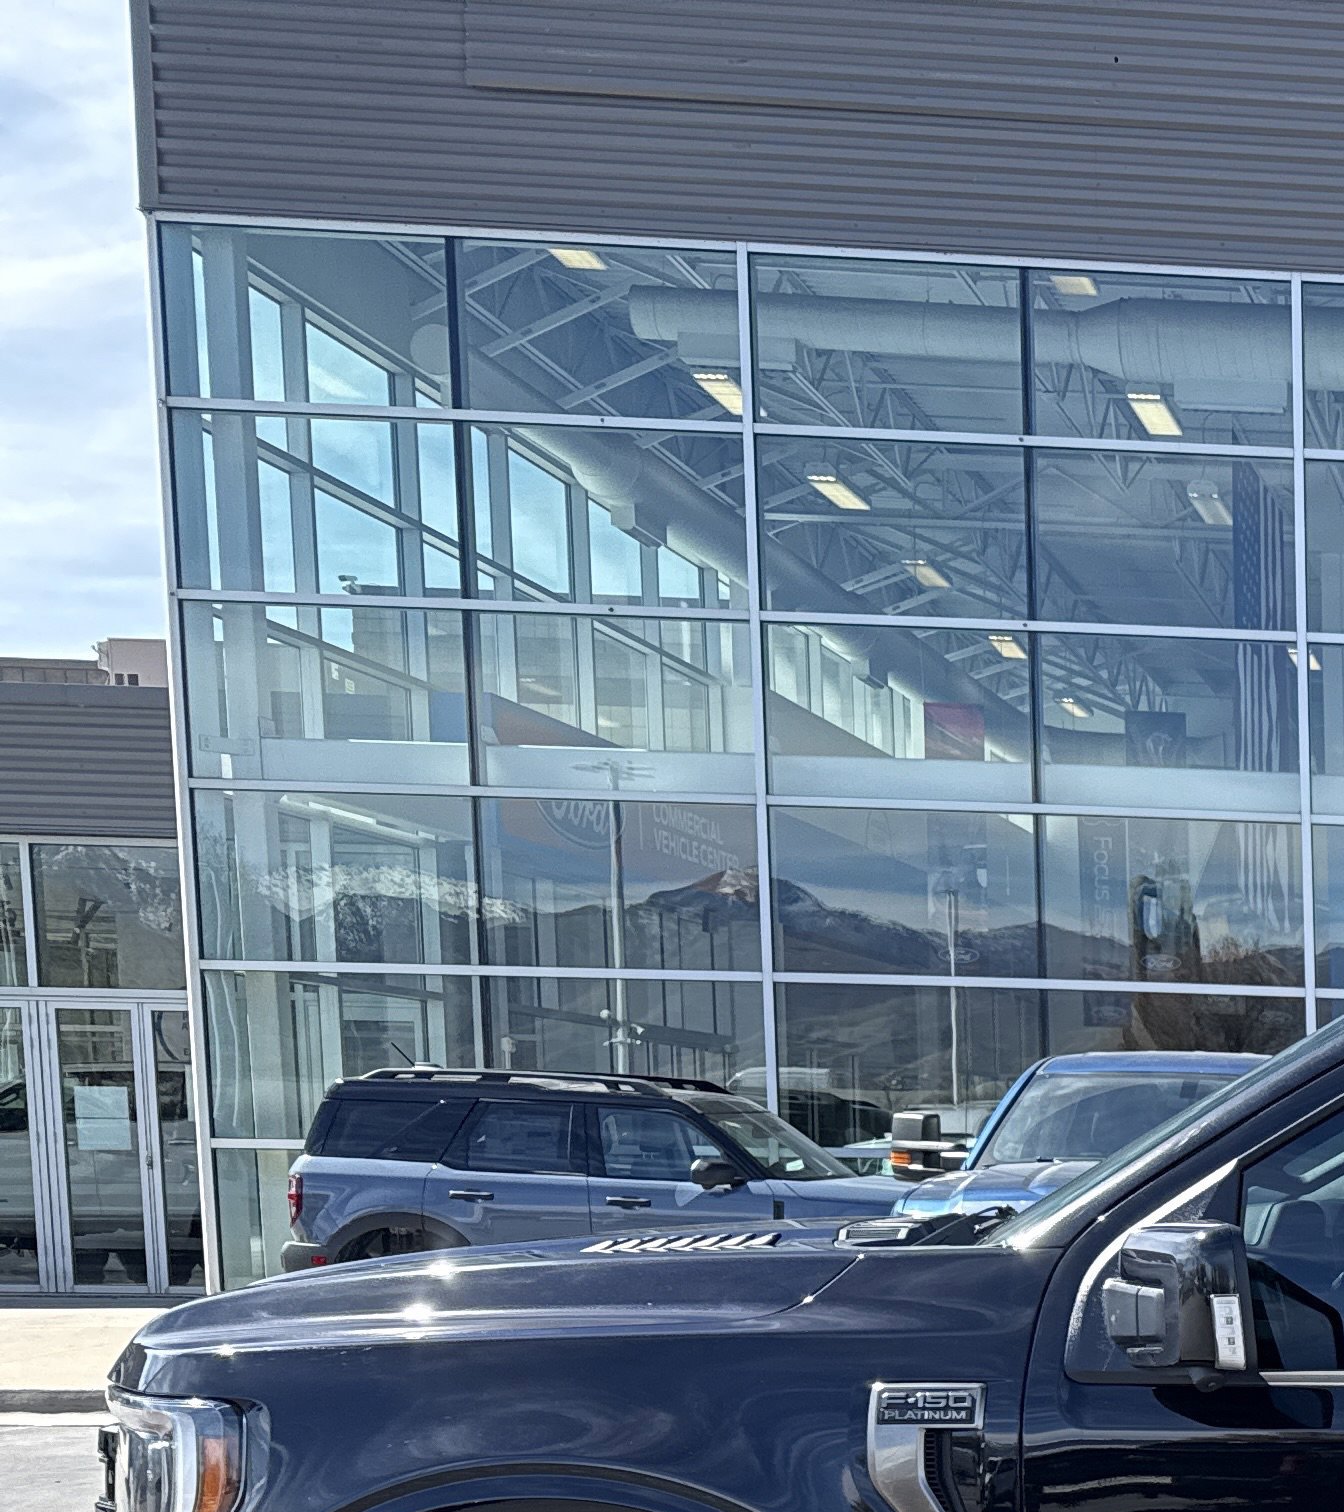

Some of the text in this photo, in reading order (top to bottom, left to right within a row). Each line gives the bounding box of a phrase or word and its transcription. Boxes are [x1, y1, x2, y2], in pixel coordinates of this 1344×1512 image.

[653, 803, 724, 845] COMMERCIAL
[654, 828, 740, 873] VEHICLE CENTER
[881, 1392, 973, 1408] F-150
[883, 1409, 967, 1420] PLATINUM
